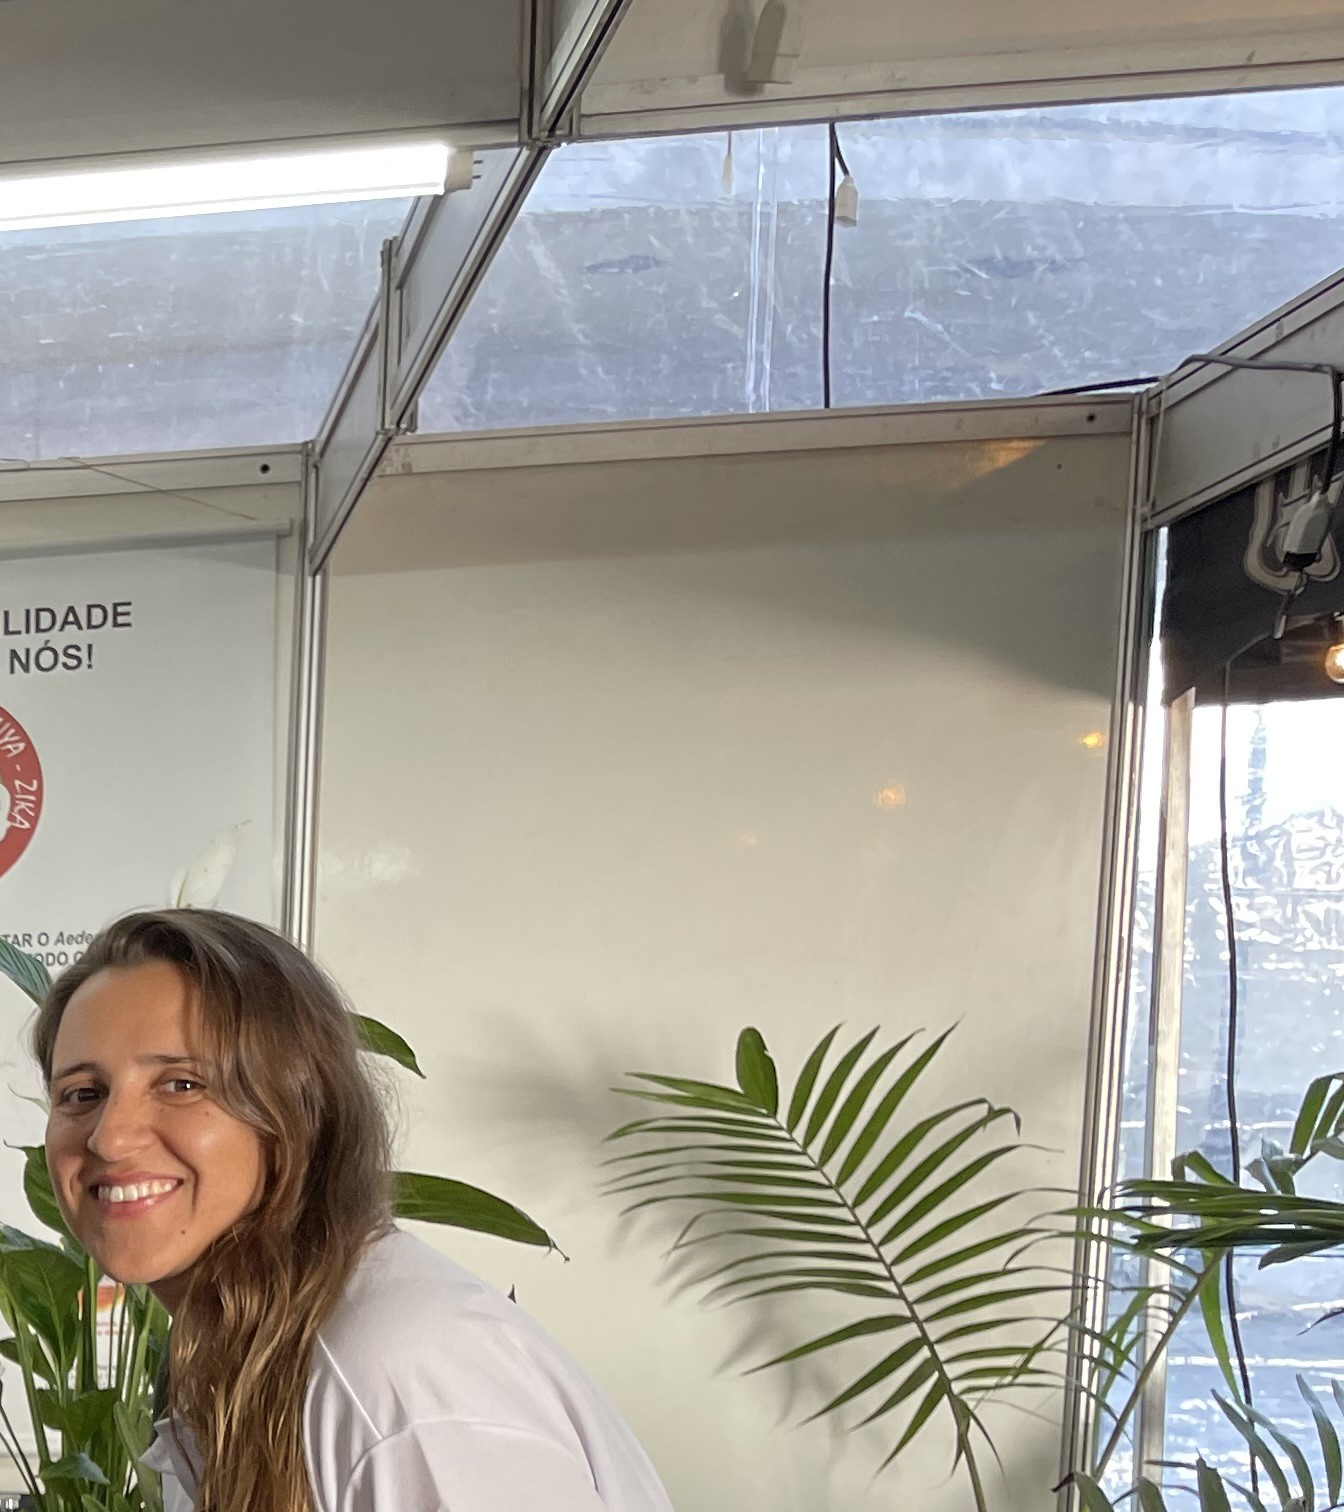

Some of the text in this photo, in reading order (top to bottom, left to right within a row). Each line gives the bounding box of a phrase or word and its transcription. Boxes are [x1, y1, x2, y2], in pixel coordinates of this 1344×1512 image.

[9, 640, 95, 675] NÓS!
[11, 779, 38, 830] ZIKA
[37, 932, 50, 946] O
[54, 930, 95, 946] Aede
